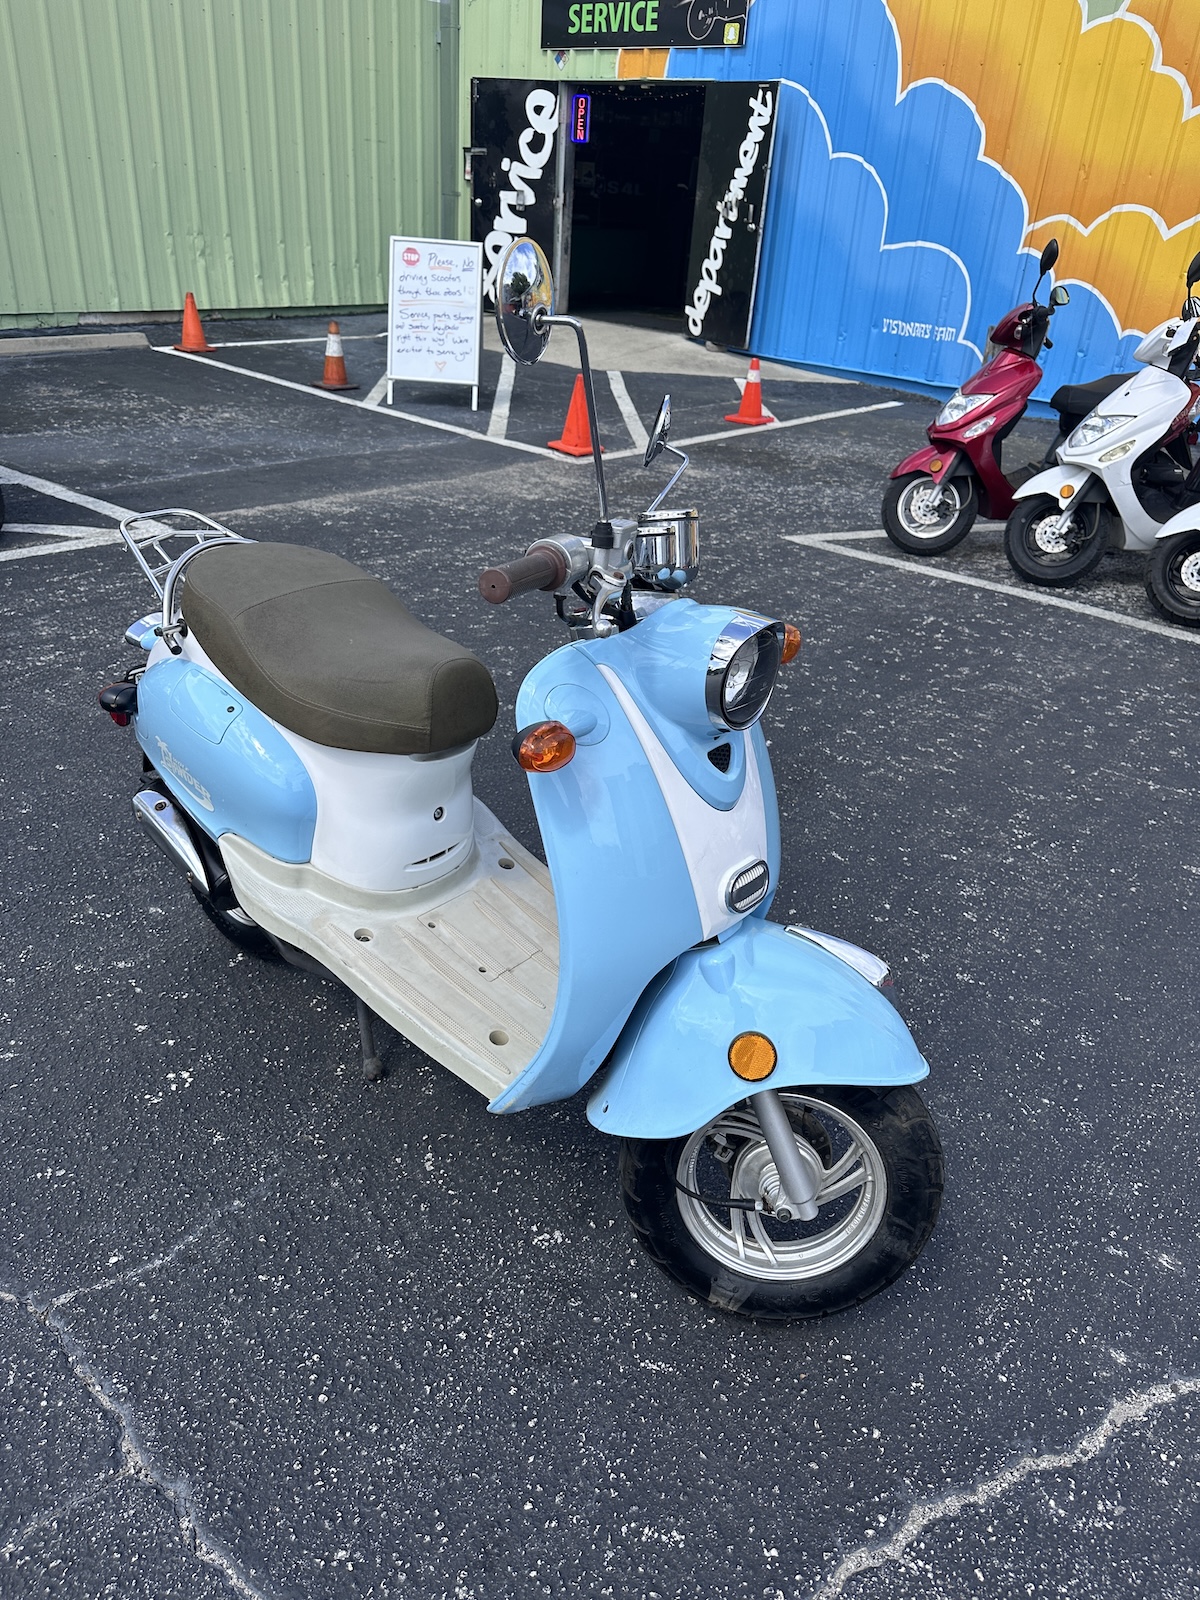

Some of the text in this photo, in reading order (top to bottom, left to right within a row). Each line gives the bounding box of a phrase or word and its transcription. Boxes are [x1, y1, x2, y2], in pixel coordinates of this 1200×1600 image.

[568, 1, 659, 34] SERVICE
[577, 98, 586, 140] OPEN
[685, 89, 772, 336] department
[403, 252, 419, 262] STOP
[462, 257, 474, 268] No
[399, 271, 428, 286] driving
[397, 285, 421, 299] through
[882, 318, 957, 341] VISIONARY FAM
